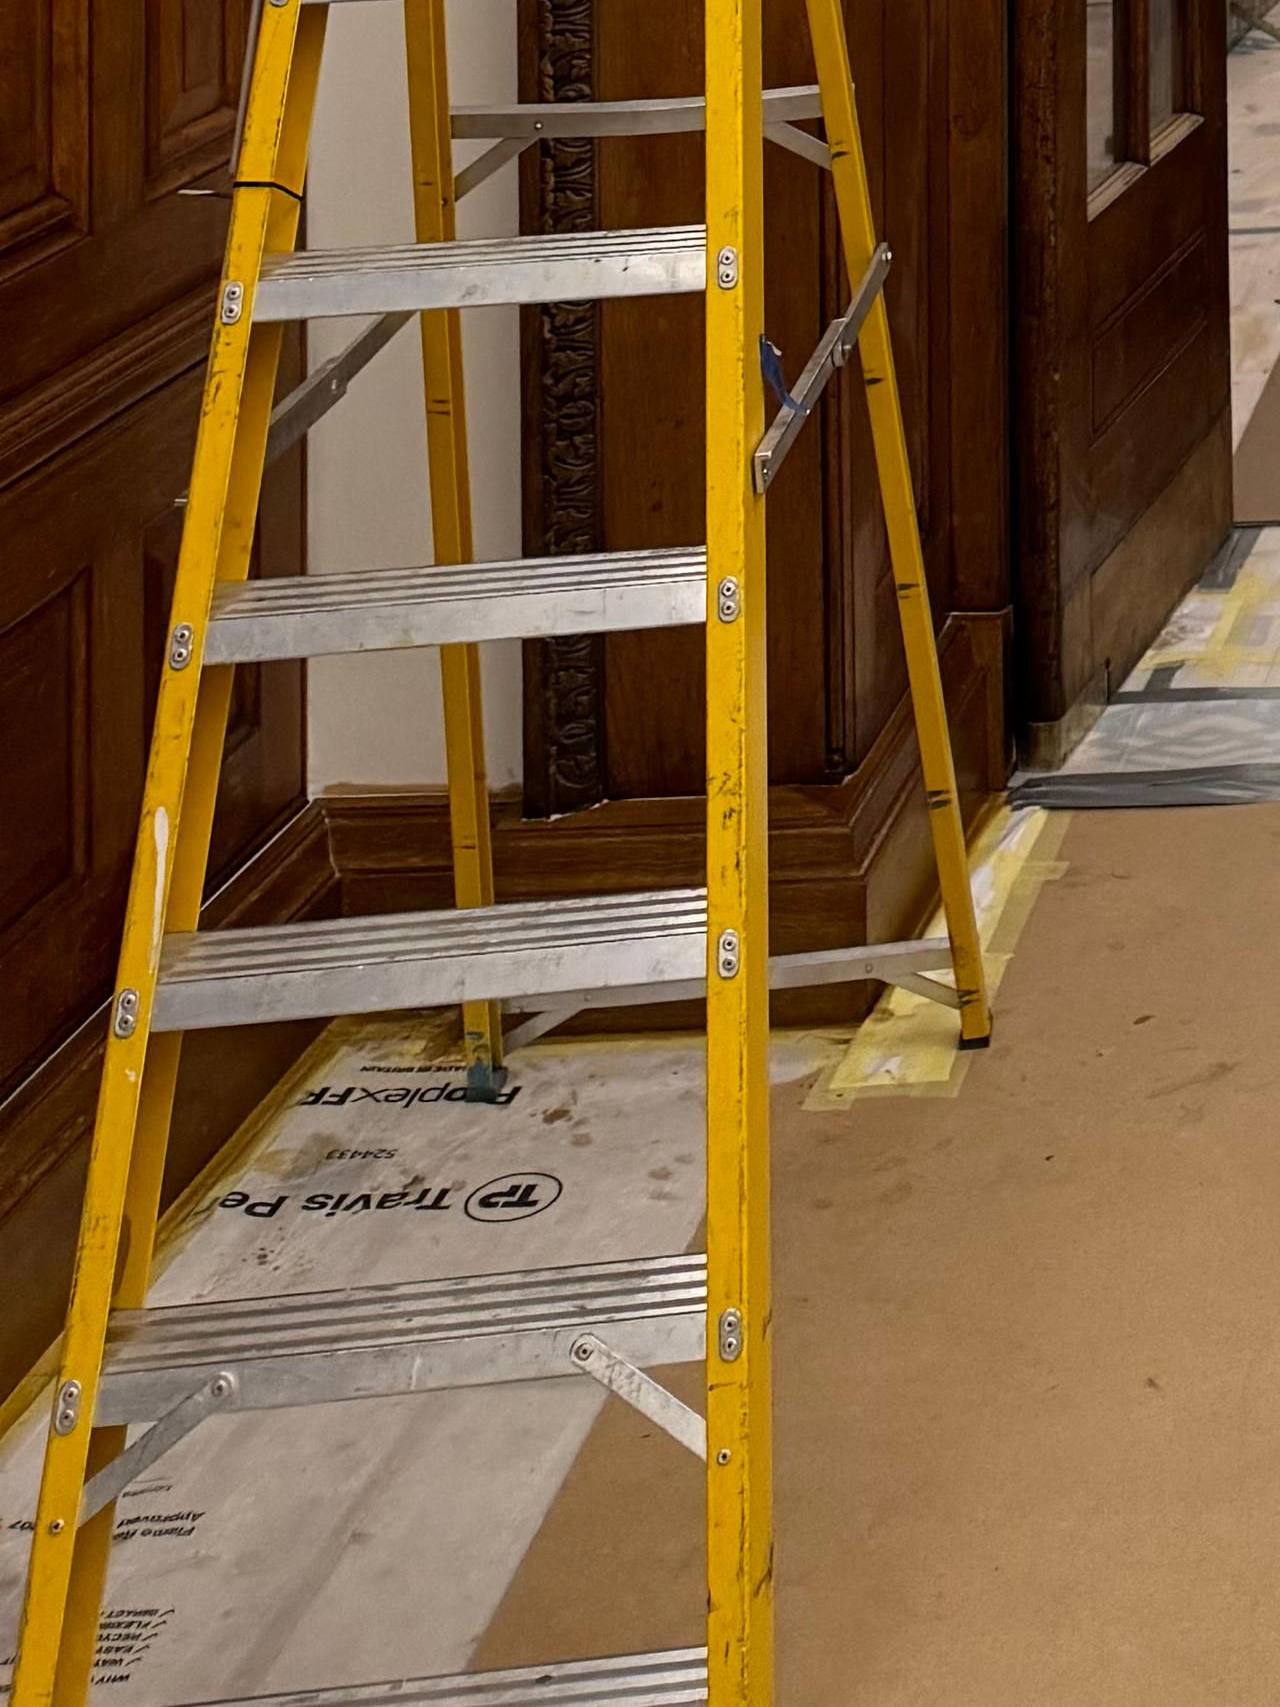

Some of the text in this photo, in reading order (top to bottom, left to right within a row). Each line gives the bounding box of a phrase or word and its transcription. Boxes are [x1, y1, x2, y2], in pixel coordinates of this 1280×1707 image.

[325, 1148, 399, 1160] 524433
[217, 1191, 289, 1219] Pe
[300, 1187, 453, 1218] Travis
[116, 1511, 206, 1530] Approved
[140, 1526, 196, 1537] Flame
